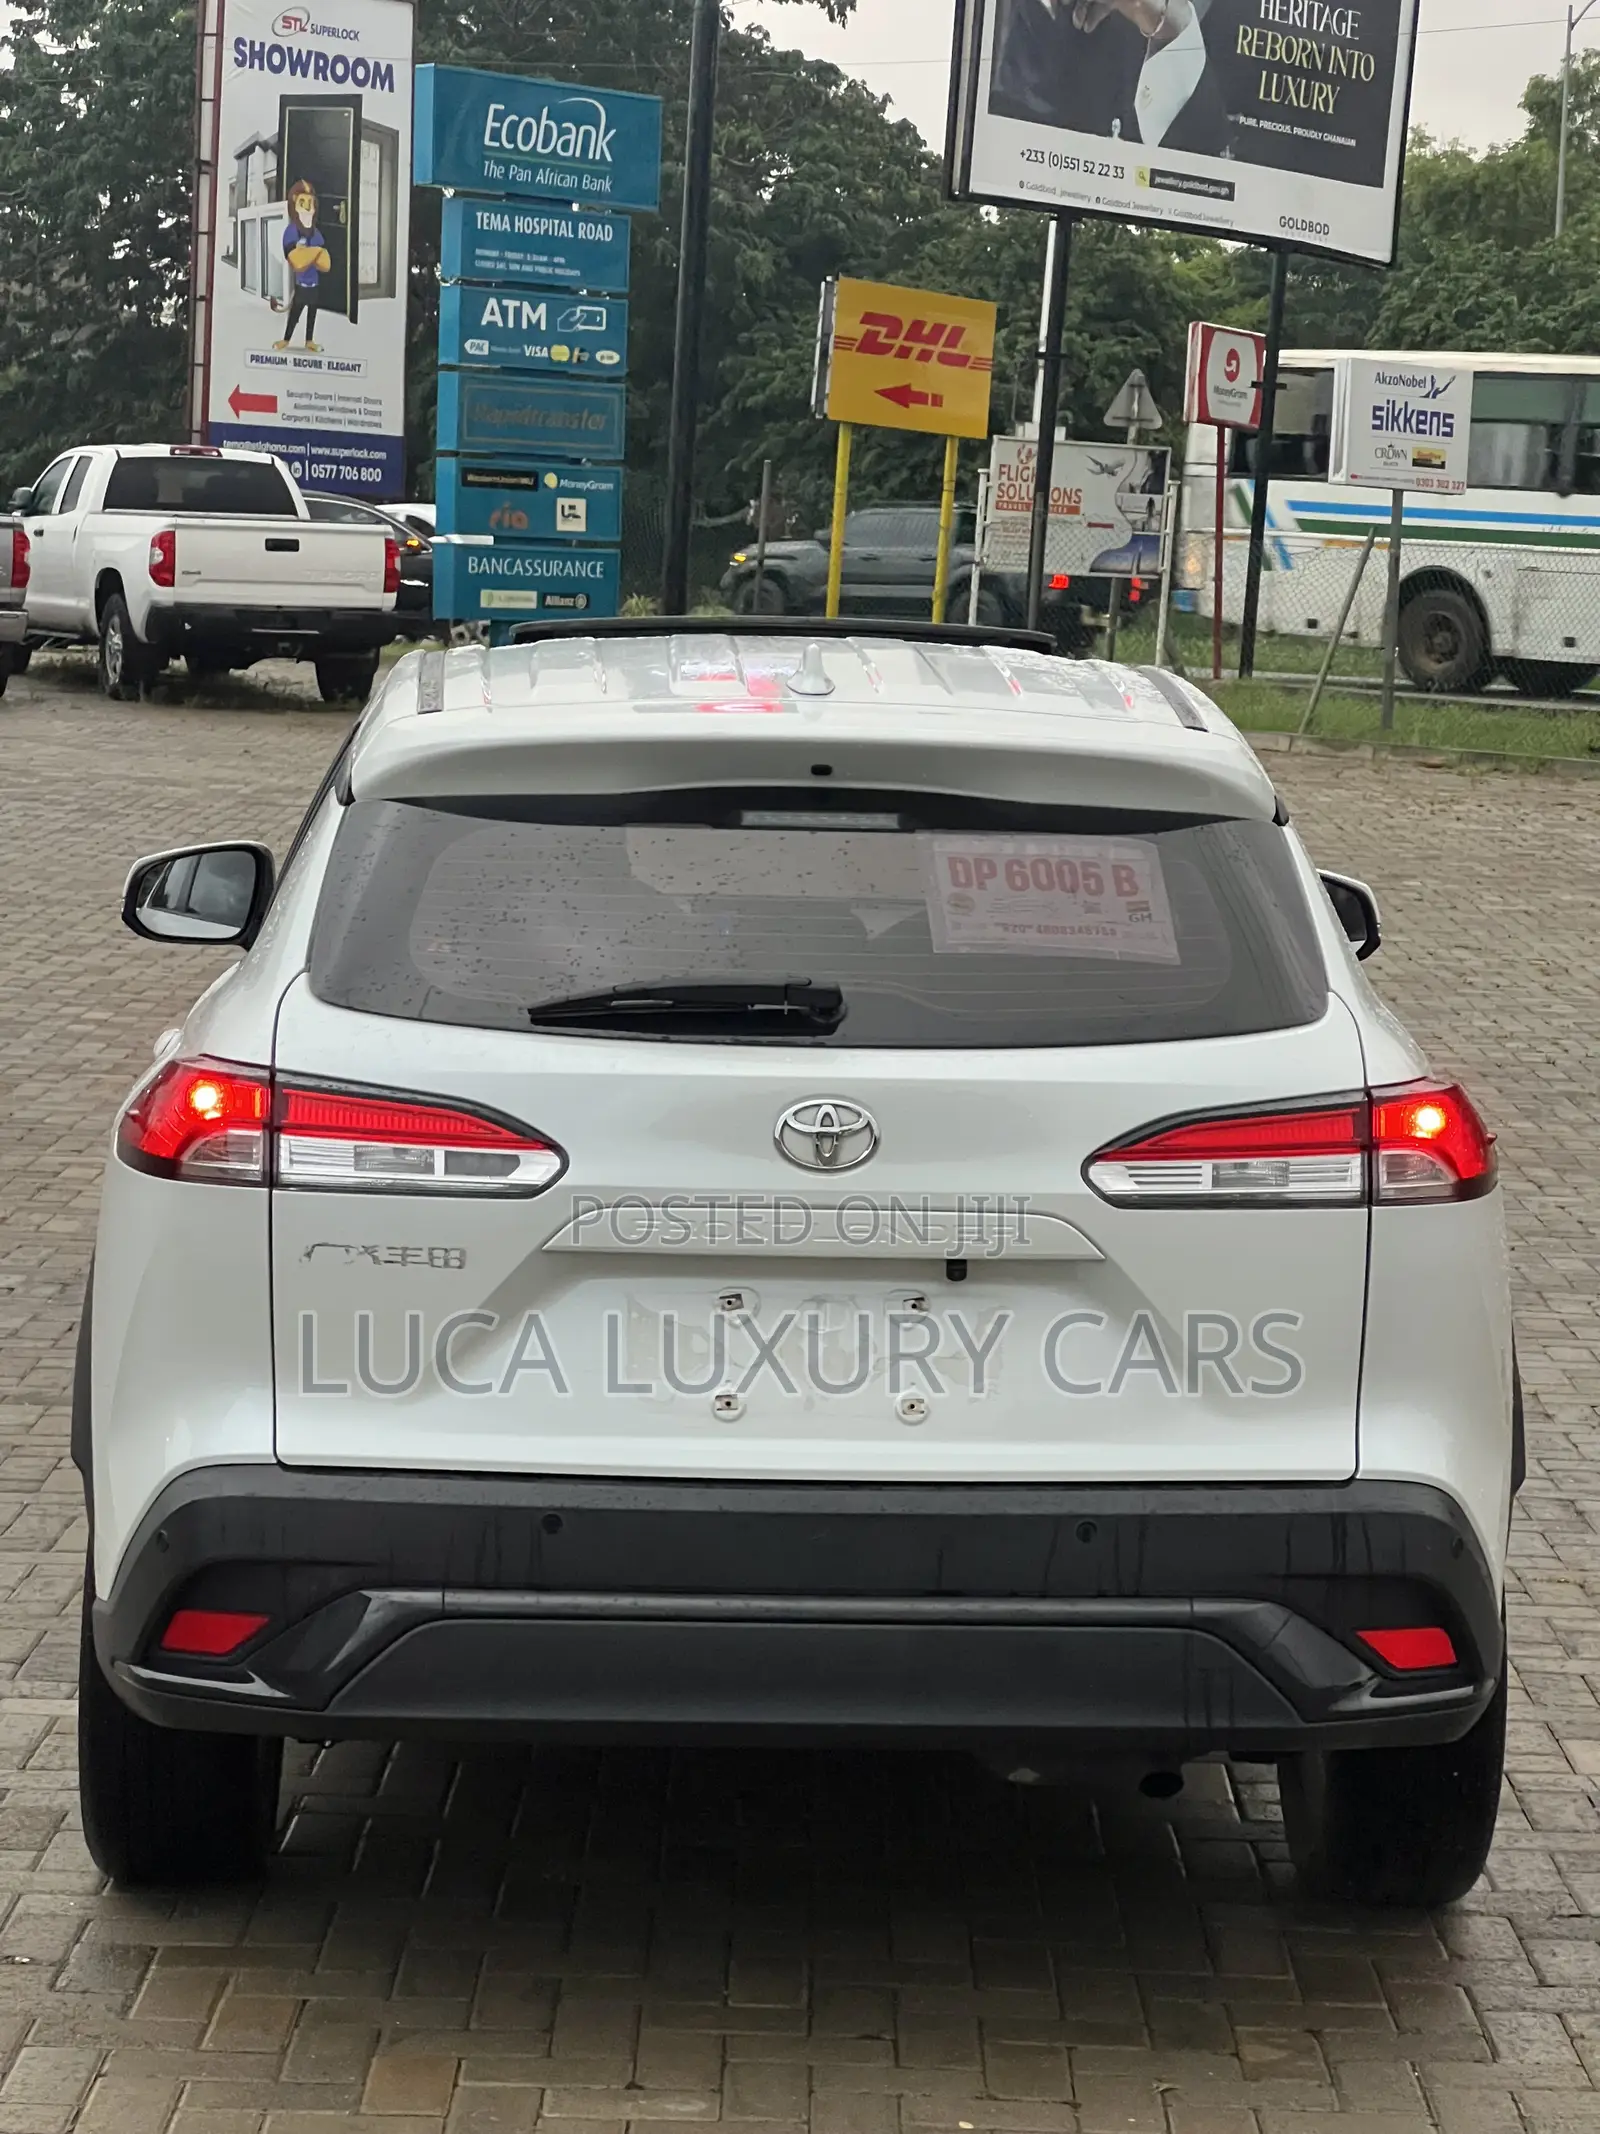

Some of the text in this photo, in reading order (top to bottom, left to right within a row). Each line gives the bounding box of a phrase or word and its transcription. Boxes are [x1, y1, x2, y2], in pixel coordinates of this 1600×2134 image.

[1260, 0, 1361, 40] HERITAGE
[310, 23, 360, 41] SUPERLOCK
[1236, 24, 1375, 82] REBORN INTO
[233, 36, 395, 93] SHOWROOM
[1259, 70, 1340, 114] LUXURY
[484, 97, 617, 162] Ecobank
[1293, 127, 1323, 140] PROUDLY
[1020, 149, 1125, 180] +233 (0)551 52 22 33
[484, 160, 612, 193] The Pan African Bank
[476, 212, 613, 242] TEMA HOSPITAL ROAD
[1279, 215, 1330, 235] GOLDBOD
[481, 297, 547, 331] ATM
[855, 311, 971, 368] DHL
[523, 344, 549, 358] VISA
[250, 354, 361, 373] PREMIUM SECURE ELEGANT
[1374, 371, 1427, 389] AkzoNobel
[1213, 384, 1248, 400] MoneyGram
[1371, 399, 1455, 438] sikkens
[311, 445, 387, 460] www.superlock.com
[1374, 447, 1408, 460] CROWN
[311, 463, 382, 482] 0577 706 800
[559, 479, 614, 492] MoneyGram
[996, 483, 1083, 505] SOLUONS
[468, 556, 604, 578] BANCASSURANCE
[545, 595, 575, 606] Allianz
[1004, 858, 1105, 896] 6005
[1111, 864, 1139, 897] B
[1128, 913, 1153, 923] GH
